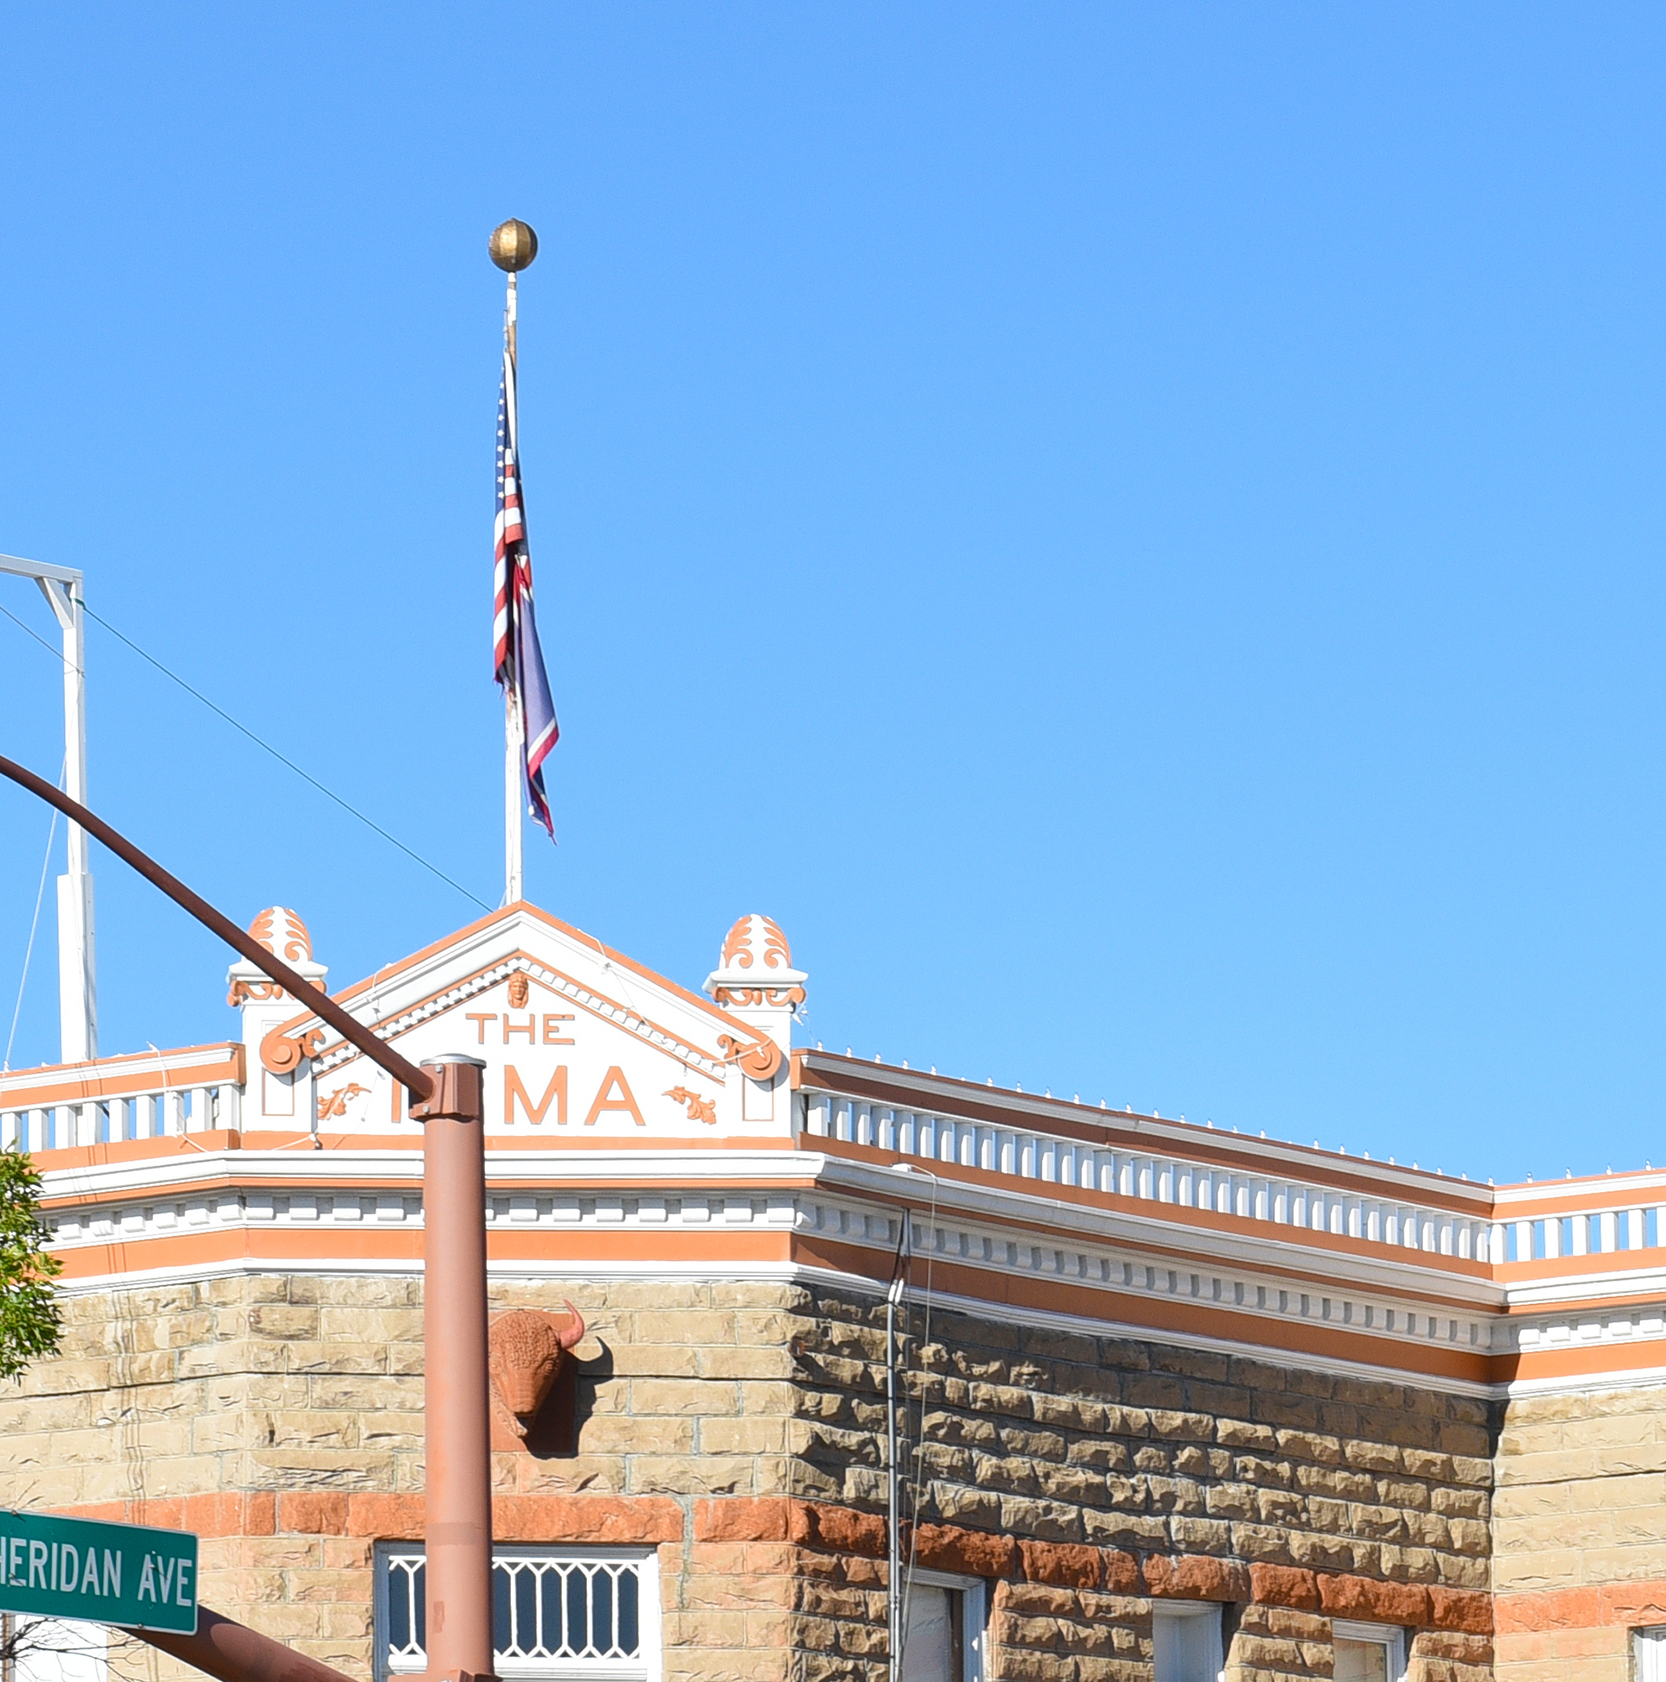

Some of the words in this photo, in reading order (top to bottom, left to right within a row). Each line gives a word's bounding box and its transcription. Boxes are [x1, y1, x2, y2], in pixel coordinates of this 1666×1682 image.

[465, 1012, 575, 1045] THE
[390, 1064, 646, 1127] IMA
[137, 1553, 193, 1607] AVE
